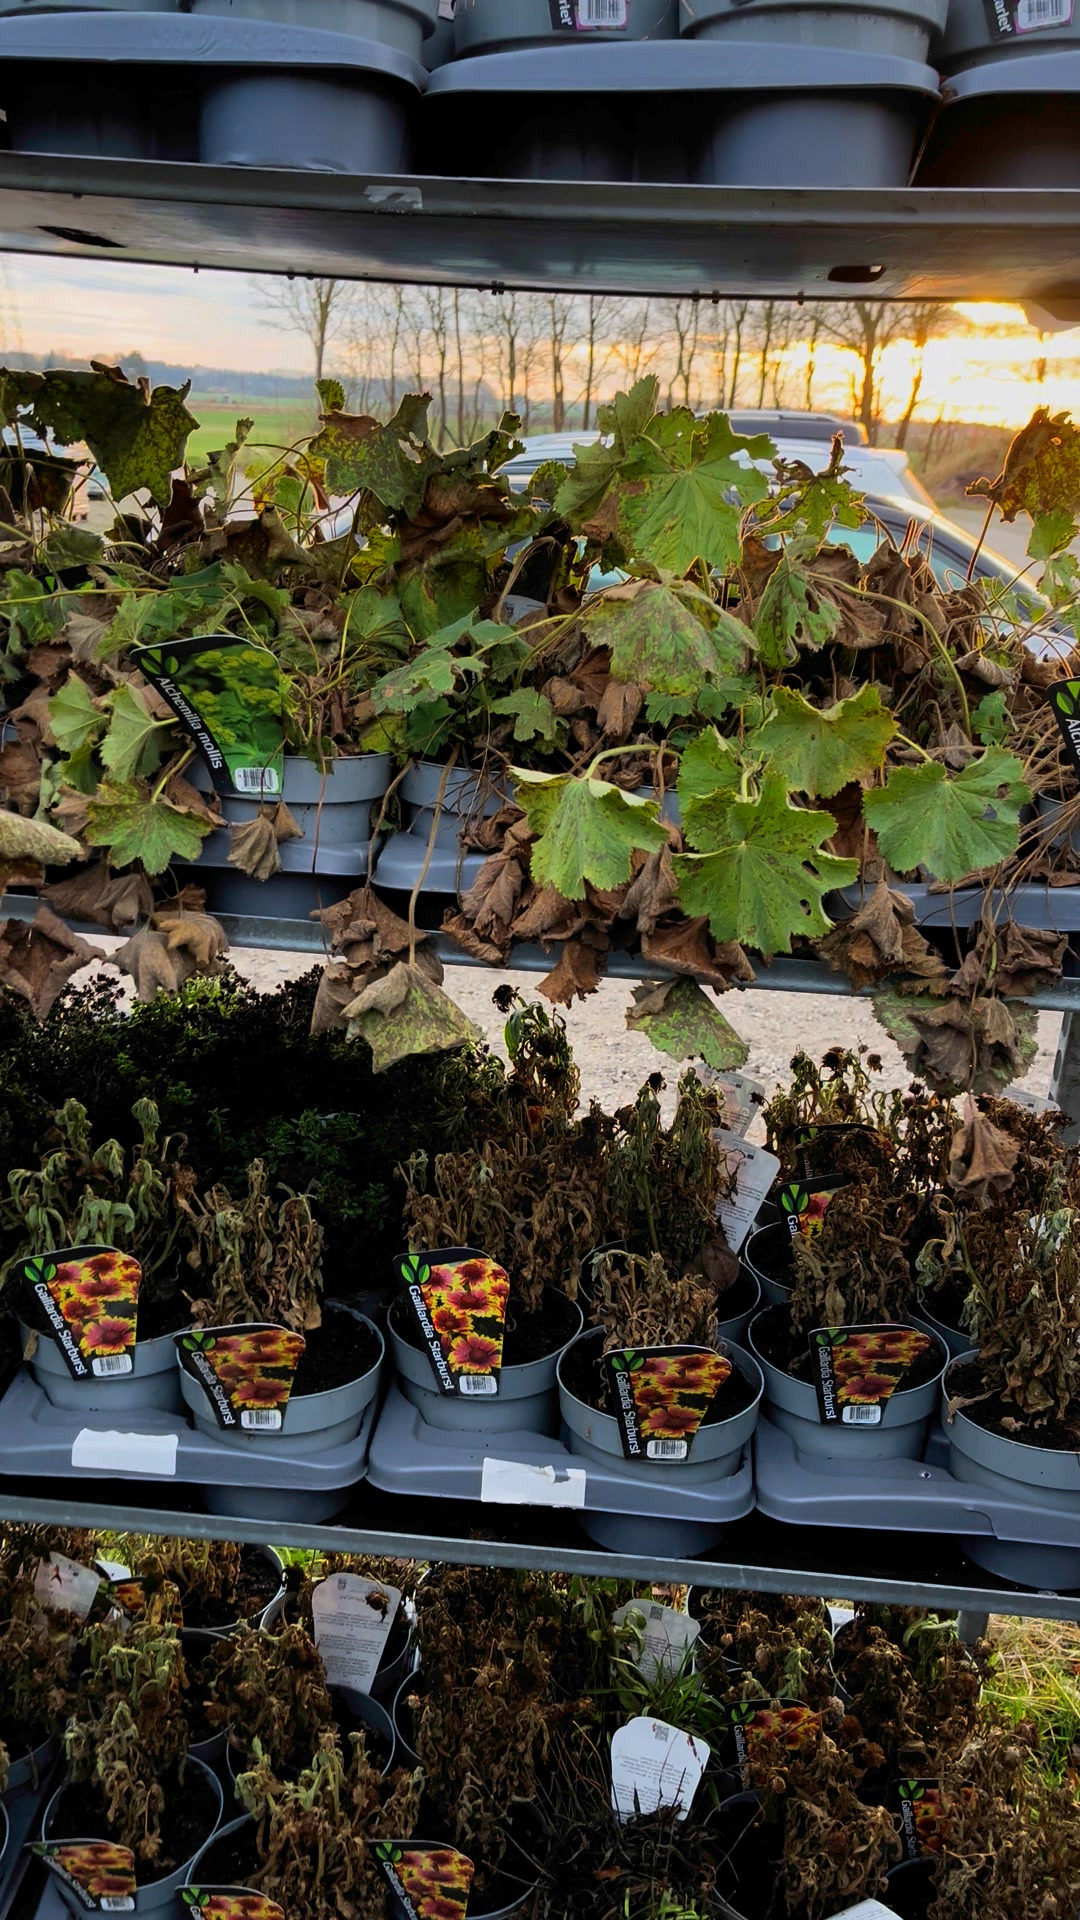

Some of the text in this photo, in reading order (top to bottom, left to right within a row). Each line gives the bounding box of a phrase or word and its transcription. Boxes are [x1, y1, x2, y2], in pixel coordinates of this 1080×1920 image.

[156, 677, 223, 769] Alchemilla mollis
[34, 1283, 88, 1375] Gaillardia Starburst
[408, 1285, 455, 1390] Gaillardia Starburst
[210, 1385, 236, 1425] Starburst
[615, 1371, 641, 1454] Gaillardia Starburst
[818, 1346, 837, 1419] Gaillardia Starburst
